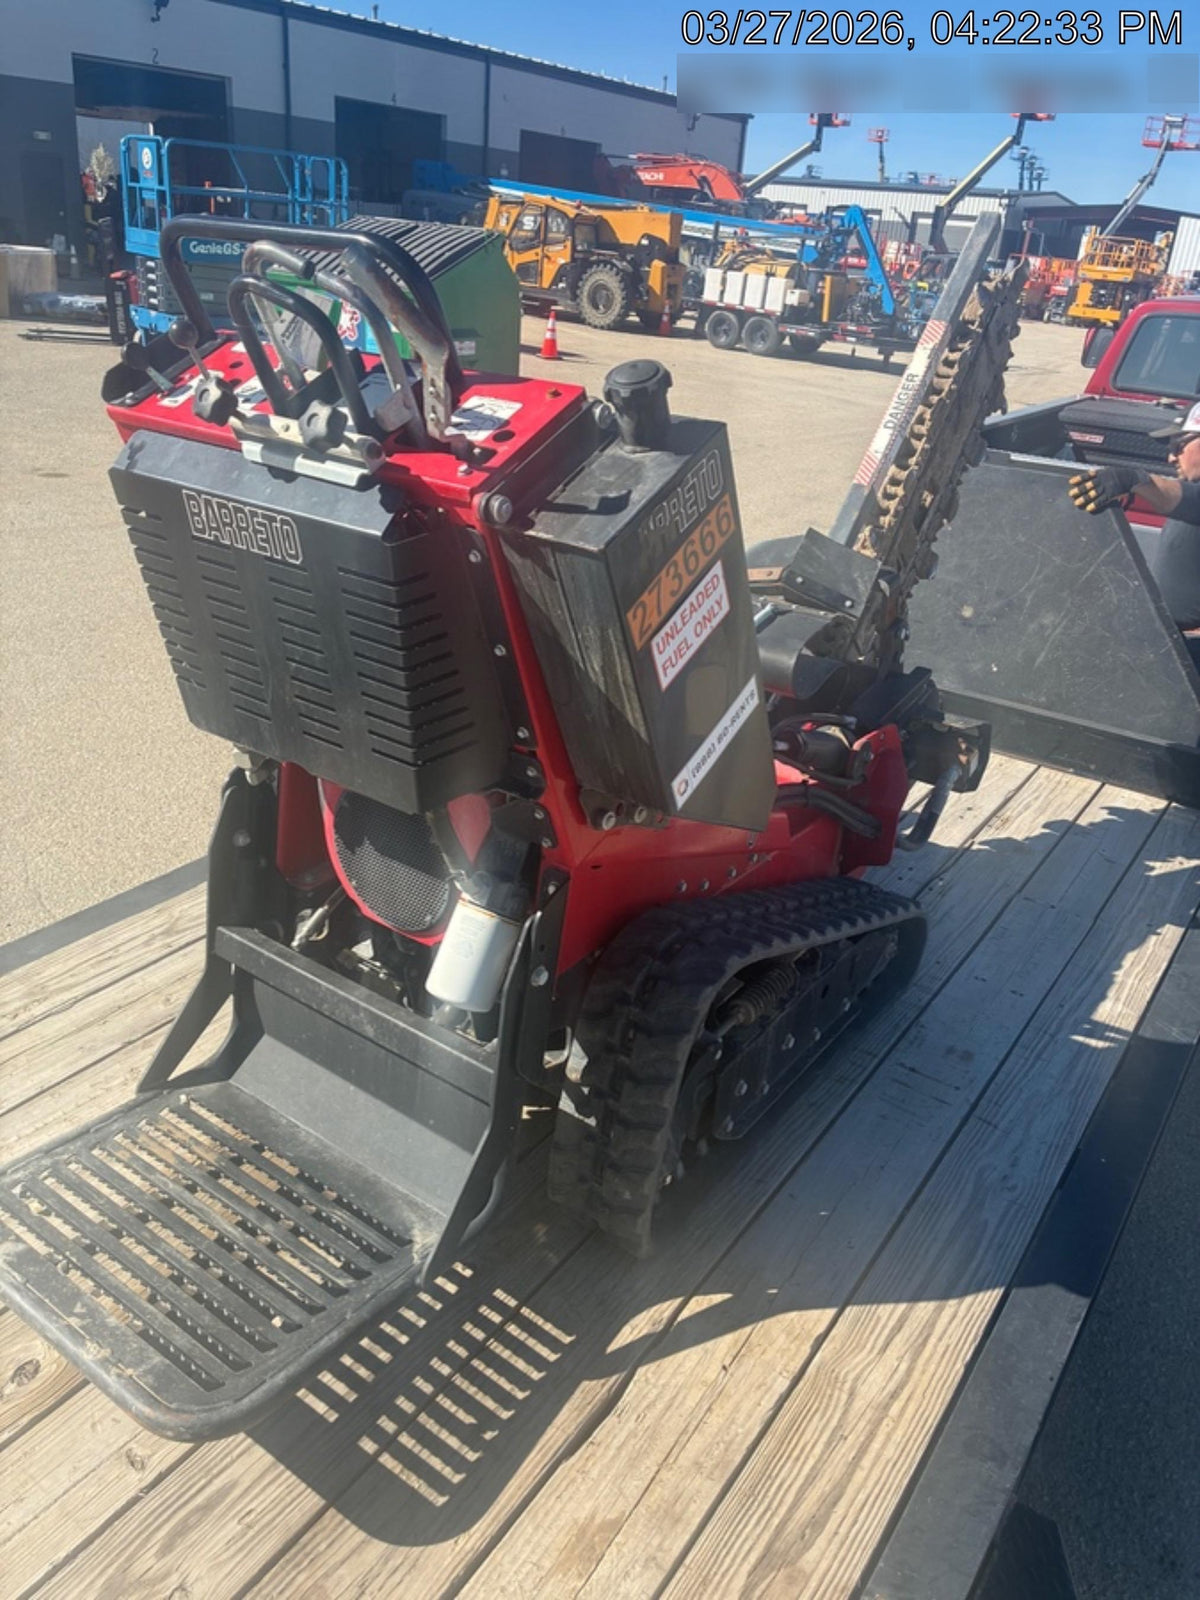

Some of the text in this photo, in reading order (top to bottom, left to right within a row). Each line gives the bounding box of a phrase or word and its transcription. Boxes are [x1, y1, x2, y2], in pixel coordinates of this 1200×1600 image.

[883, 373, 919, 431] DANGER
[182, 489, 303, 565] BARRETO
[631, 499, 732, 644] 273666
[655, 573, 720, 655] UNLEADED
[662, 593, 724, 678] FUEL ONLY
